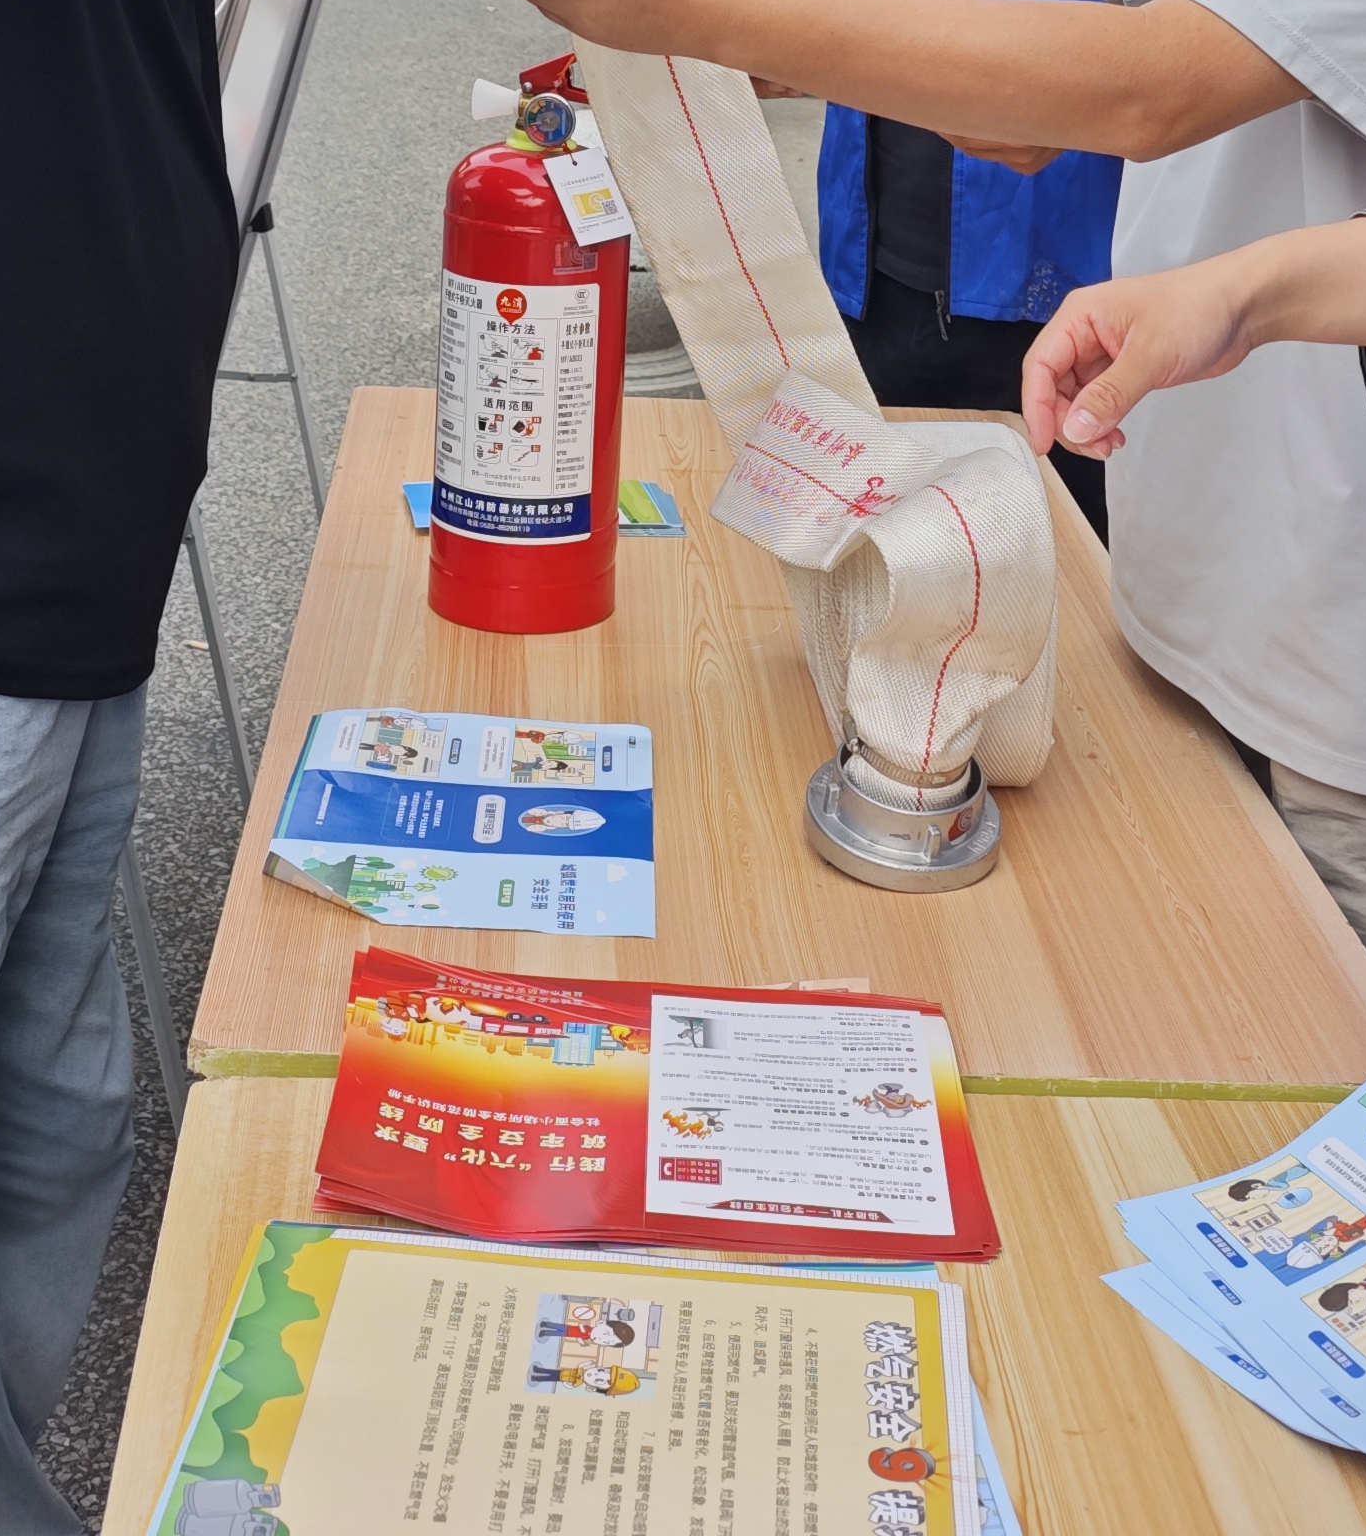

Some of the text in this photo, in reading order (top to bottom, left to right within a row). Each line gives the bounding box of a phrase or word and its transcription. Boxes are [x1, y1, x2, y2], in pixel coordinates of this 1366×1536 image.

[486, 320, 536, 335] 操作方法
[483, 397, 533, 412] 适用范围
[378, 1102, 608, 1150] 筑牢安全防线
